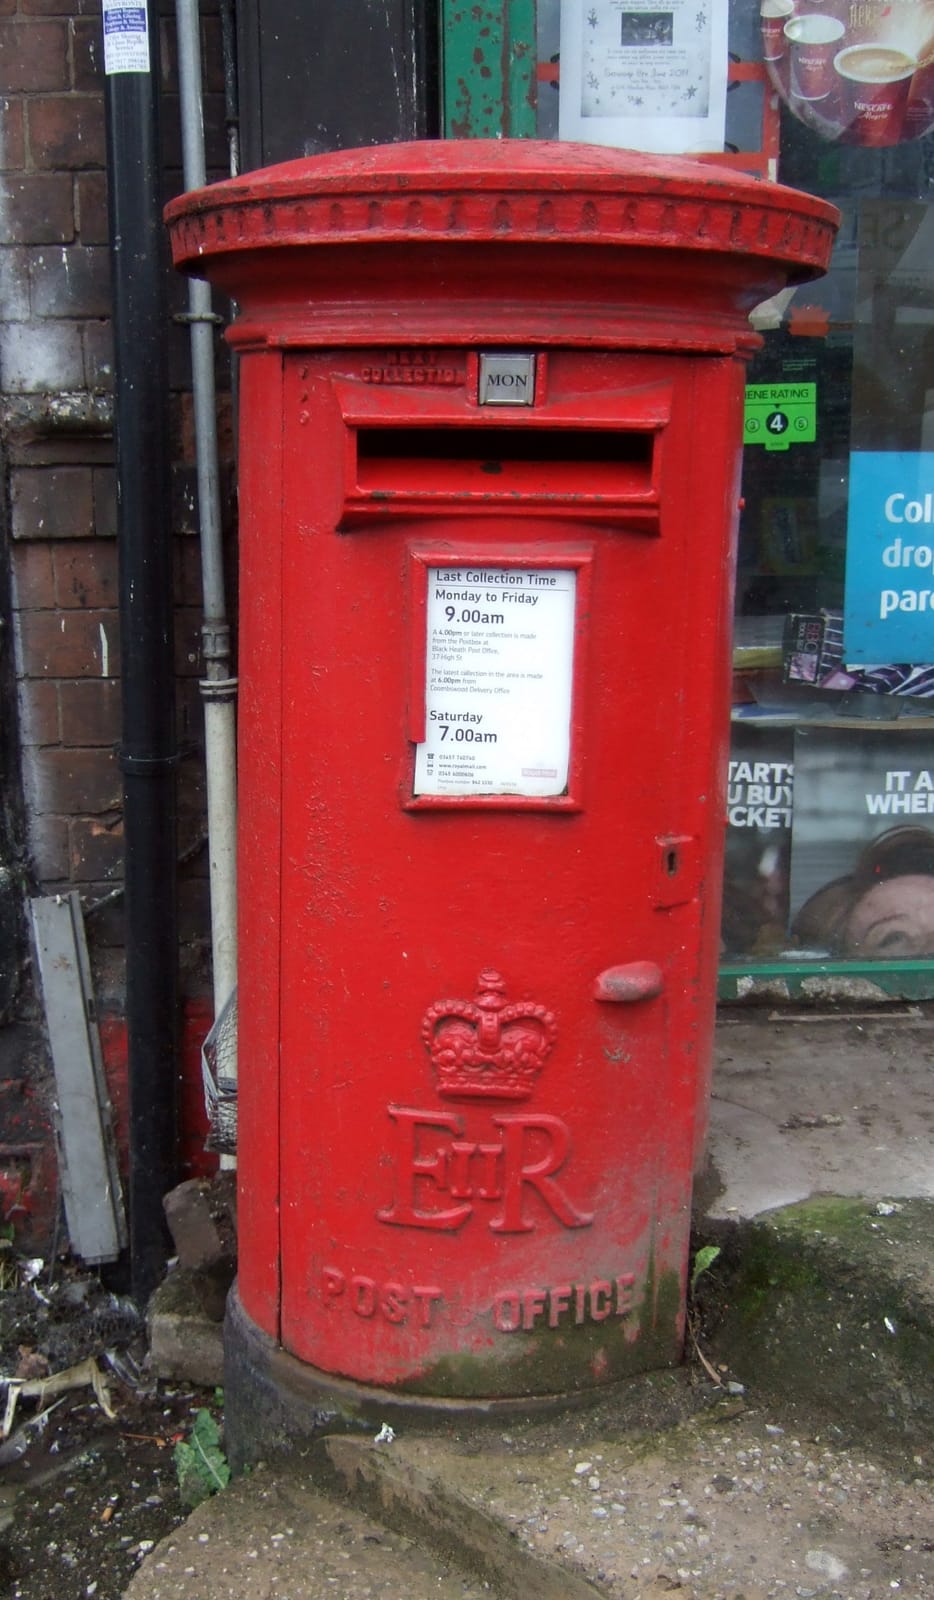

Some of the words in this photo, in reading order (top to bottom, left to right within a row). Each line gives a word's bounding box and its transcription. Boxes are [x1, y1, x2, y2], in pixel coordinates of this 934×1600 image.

[360, 368, 466, 386] COLLECTION
[487, 373, 529, 387] MON
[770, 388, 809, 399] RATING
[770, 414, 783, 432] 4
[885, 493, 934, 523] Col
[882, 538, 934, 575] dro
[436, 570, 461, 582] Last
[466, 571, 523, 585] Collection
[527, 574, 557, 586] Time
[435, 589, 481, 604] Monday
[486, 591, 497, 602] to
[502, 592, 539, 606] Friday
[444, 605, 504, 624] 9.00am
[439, 629, 462, 637] 4.00pm
[485, 631, 512, 639] collection
[438, 677, 461, 685] 6.00pm
[469, 686, 492, 694] Delivery
[430, 710, 483, 724] Saturday
[439, 725, 497, 743] 7.00am
[886, 771, 911, 791] IT
[727, 806, 793, 828] CKET
[323, 1265, 442, 1327] POST
[494, 1271, 636, 1332] OFFICE
